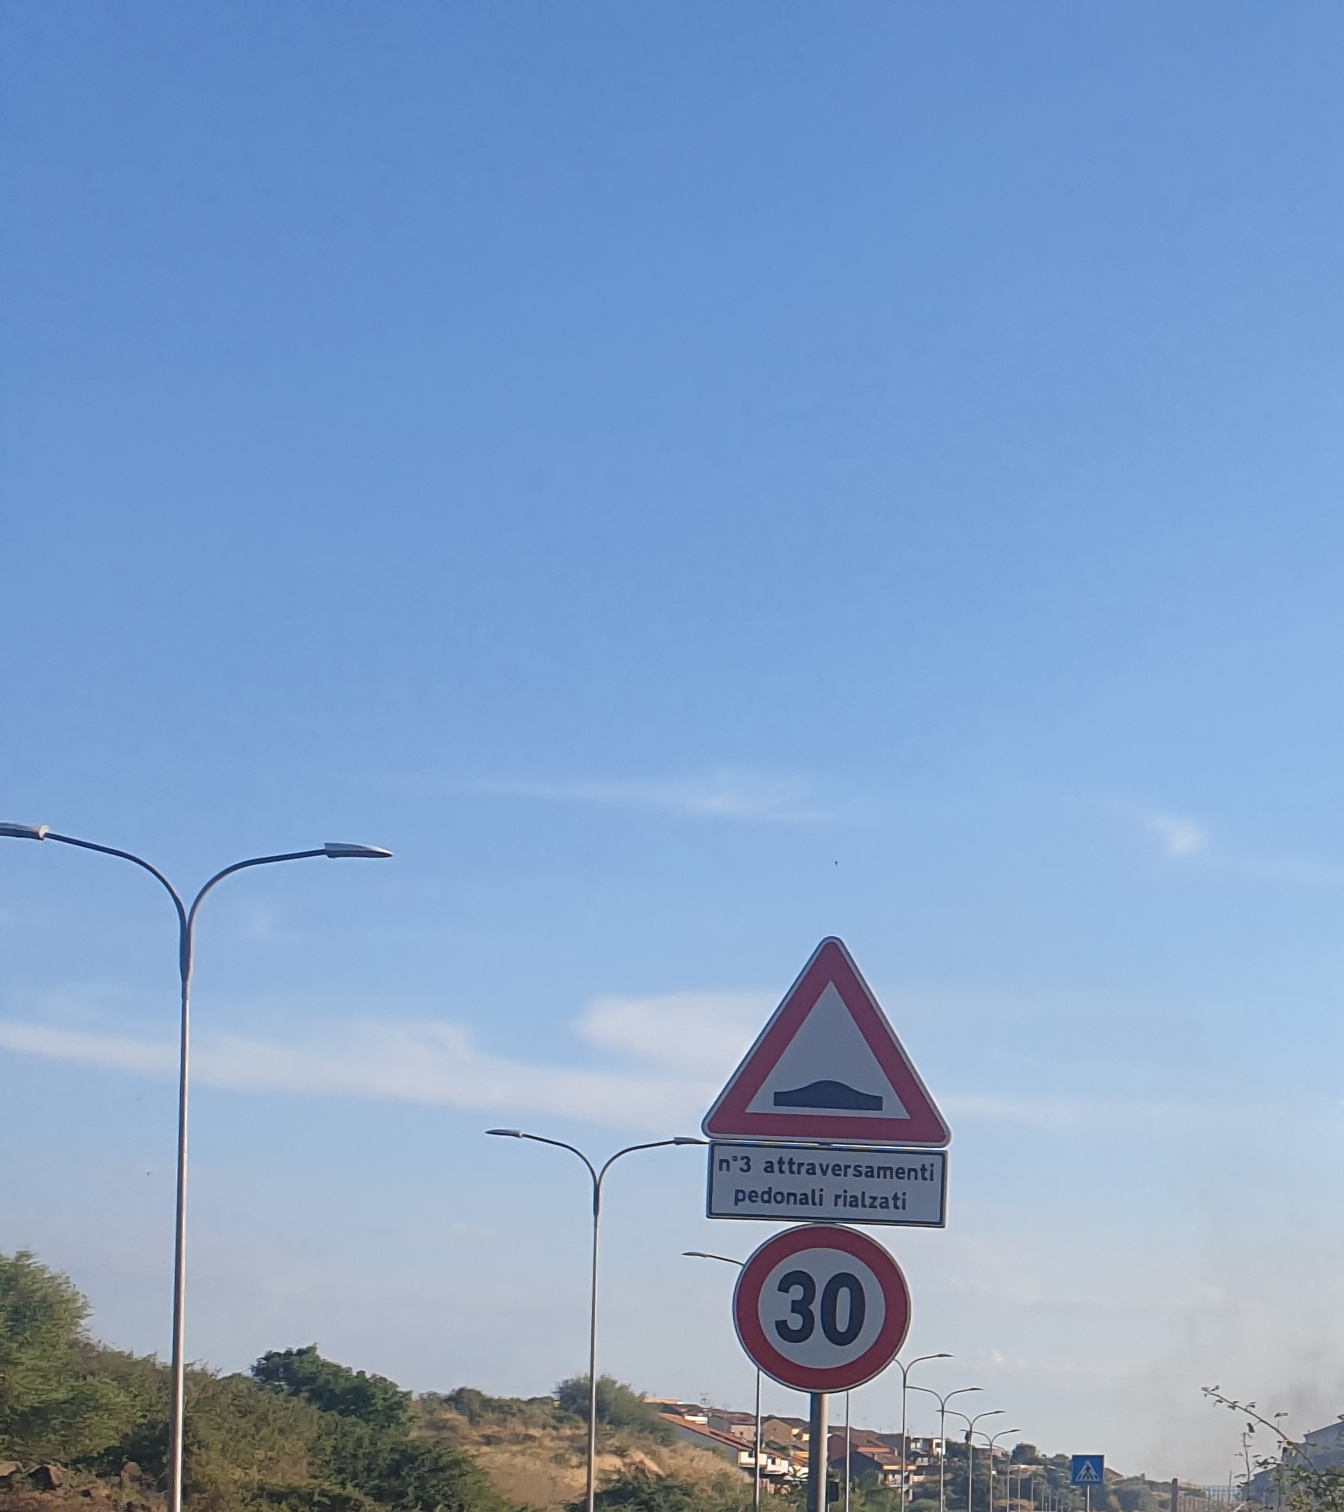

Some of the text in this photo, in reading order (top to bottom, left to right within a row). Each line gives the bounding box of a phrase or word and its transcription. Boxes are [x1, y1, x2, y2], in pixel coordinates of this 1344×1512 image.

[763, 1156, 935, 1181] attraversamenti
[733, 1187, 907, 1210] pedonali rialzati
[774, 1270, 866, 1346] 30
